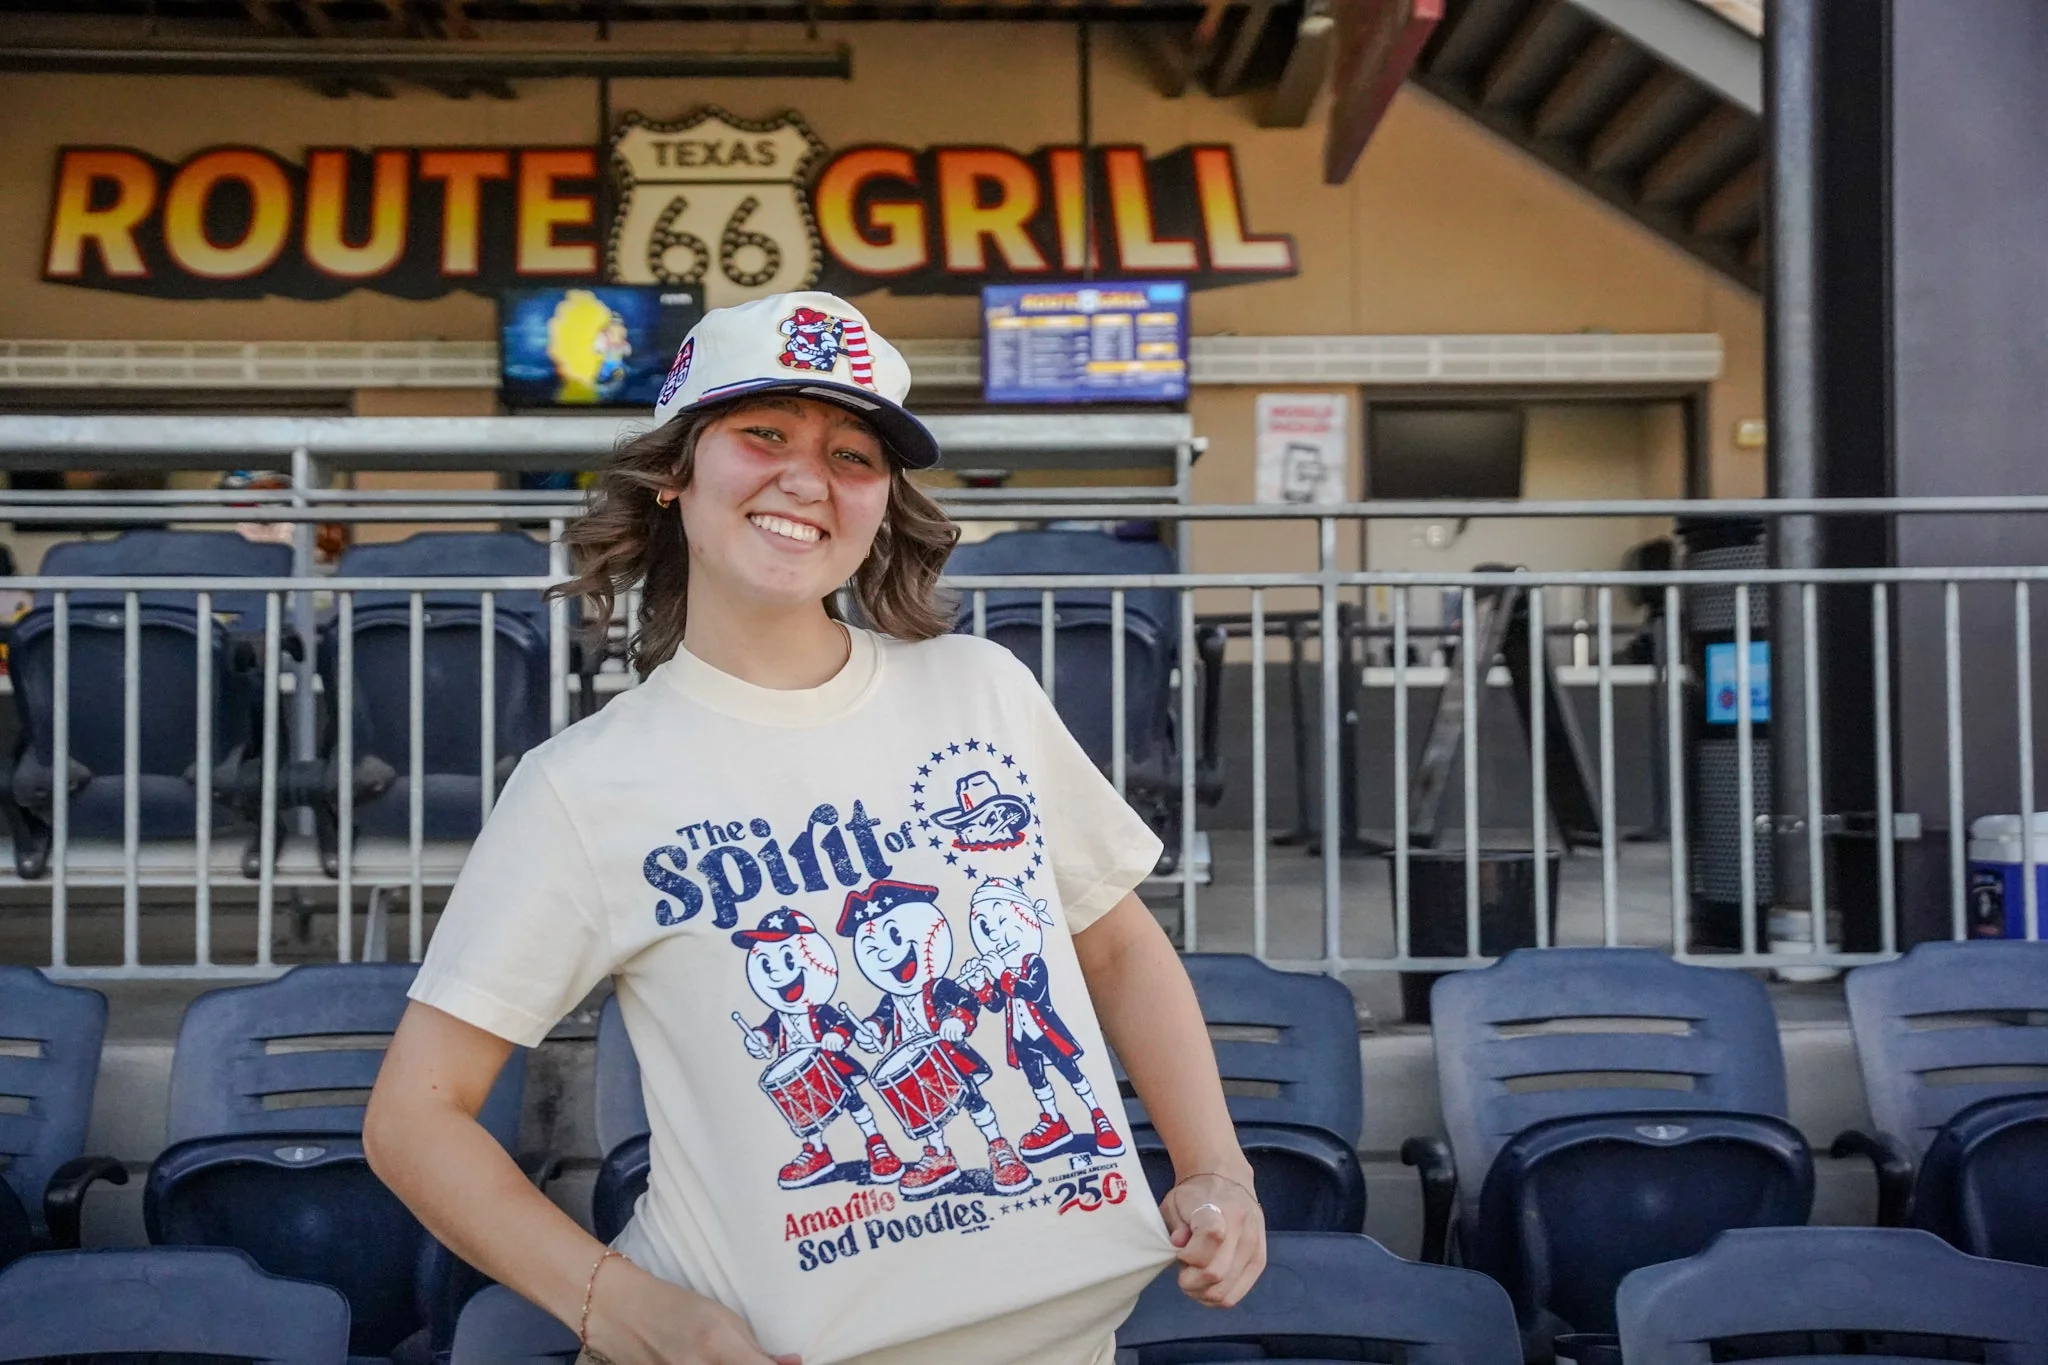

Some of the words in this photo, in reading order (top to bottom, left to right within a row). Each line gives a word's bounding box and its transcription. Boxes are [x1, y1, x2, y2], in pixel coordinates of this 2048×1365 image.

[652, 140, 777, 167] TEXAS
[45, 148, 598, 278] ROUTE
[646, 195, 781, 287] 66
[814, 147, 1294, 275] GRILL
[962, 792, 974, 809] A
[676, 820, 746, 850] The
[643, 799, 893, 929] Spirit
[885, 820, 917, 852] of
[1048, 1168, 1087, 1183] CELEBRATING
[784, 1188, 895, 1241] Amarillo
[798, 1225, 860, 1271] Sod
[864, 1200, 987, 1249] Poodles
